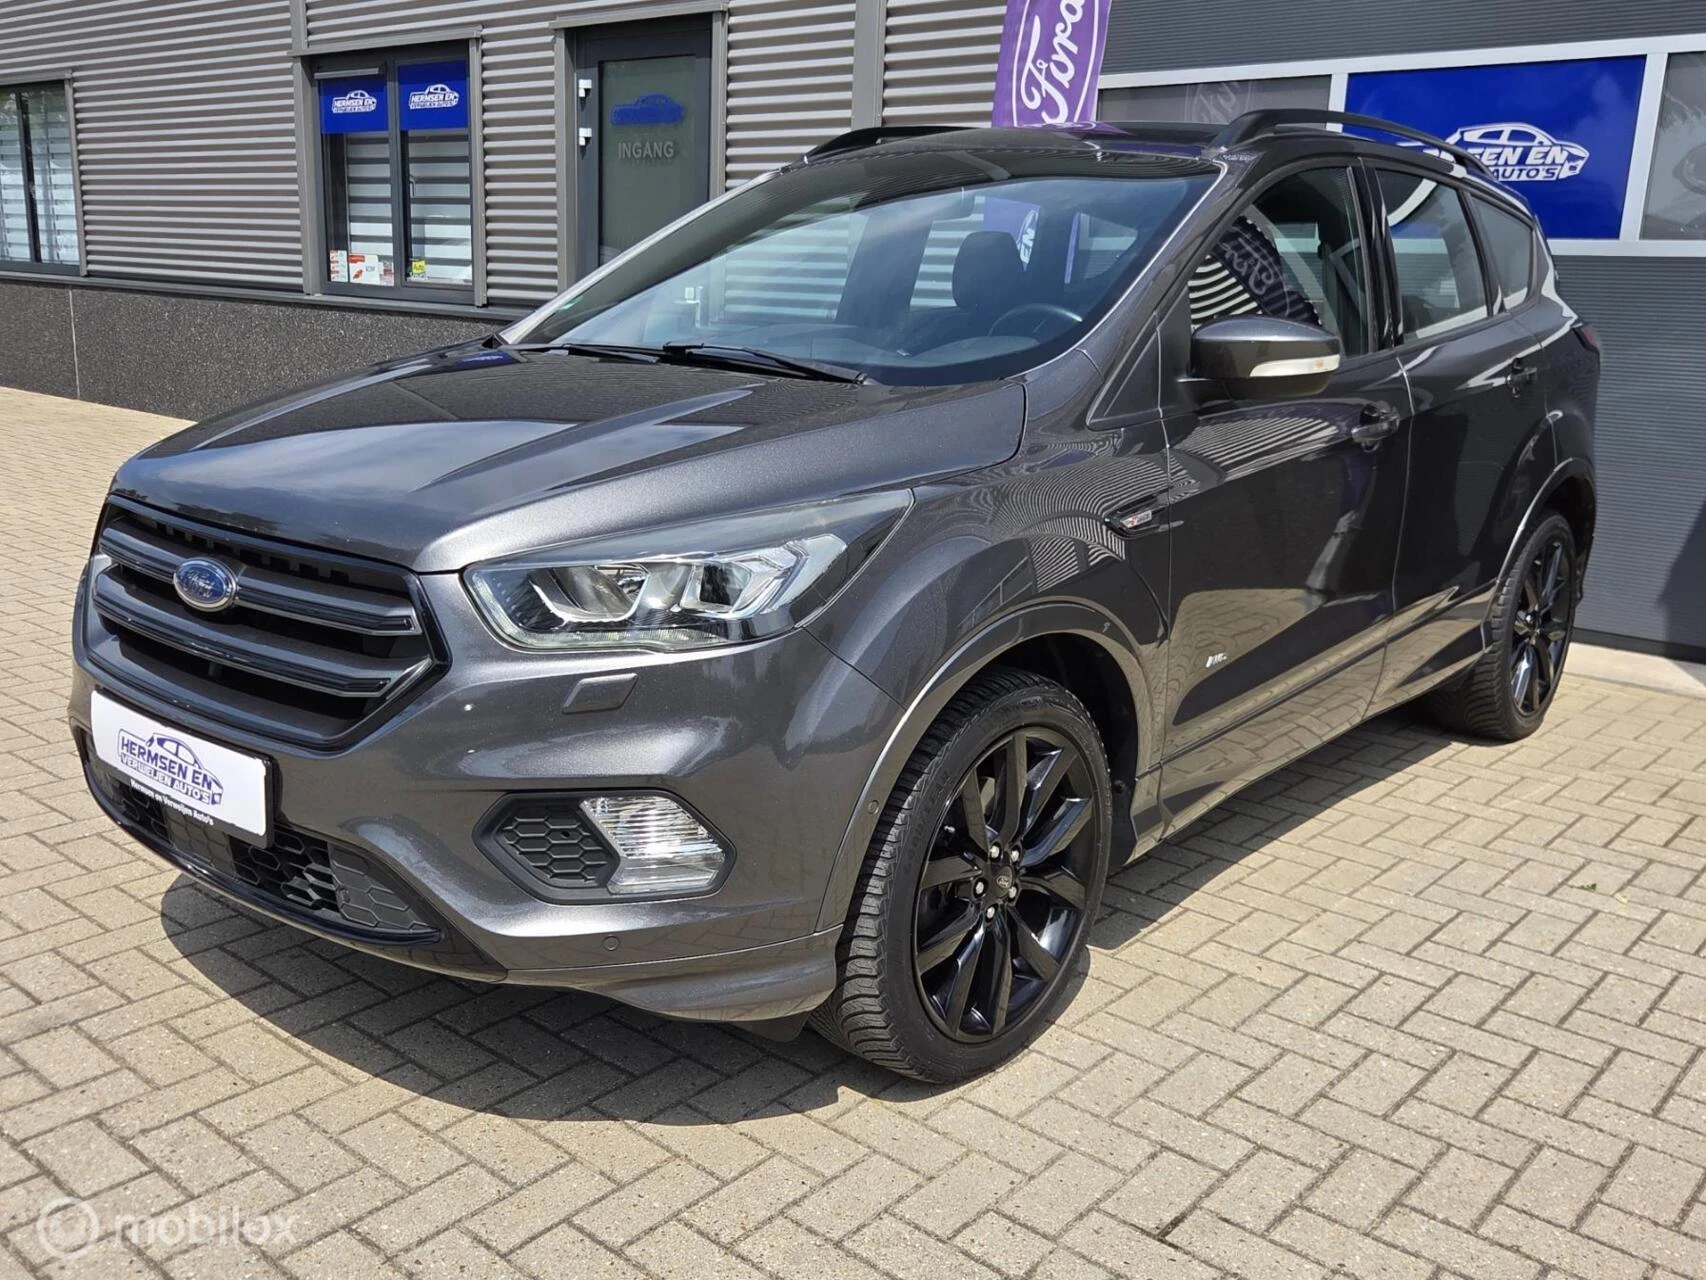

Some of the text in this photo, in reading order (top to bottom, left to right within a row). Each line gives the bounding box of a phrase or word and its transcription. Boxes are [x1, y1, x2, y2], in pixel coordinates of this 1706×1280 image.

[618, 141, 674, 159] INGANG
[1525, 146, 1569, 165] EN
[121, 736, 213, 791] HERMSEN EN
[172, 780, 211, 804] AUTO'S
